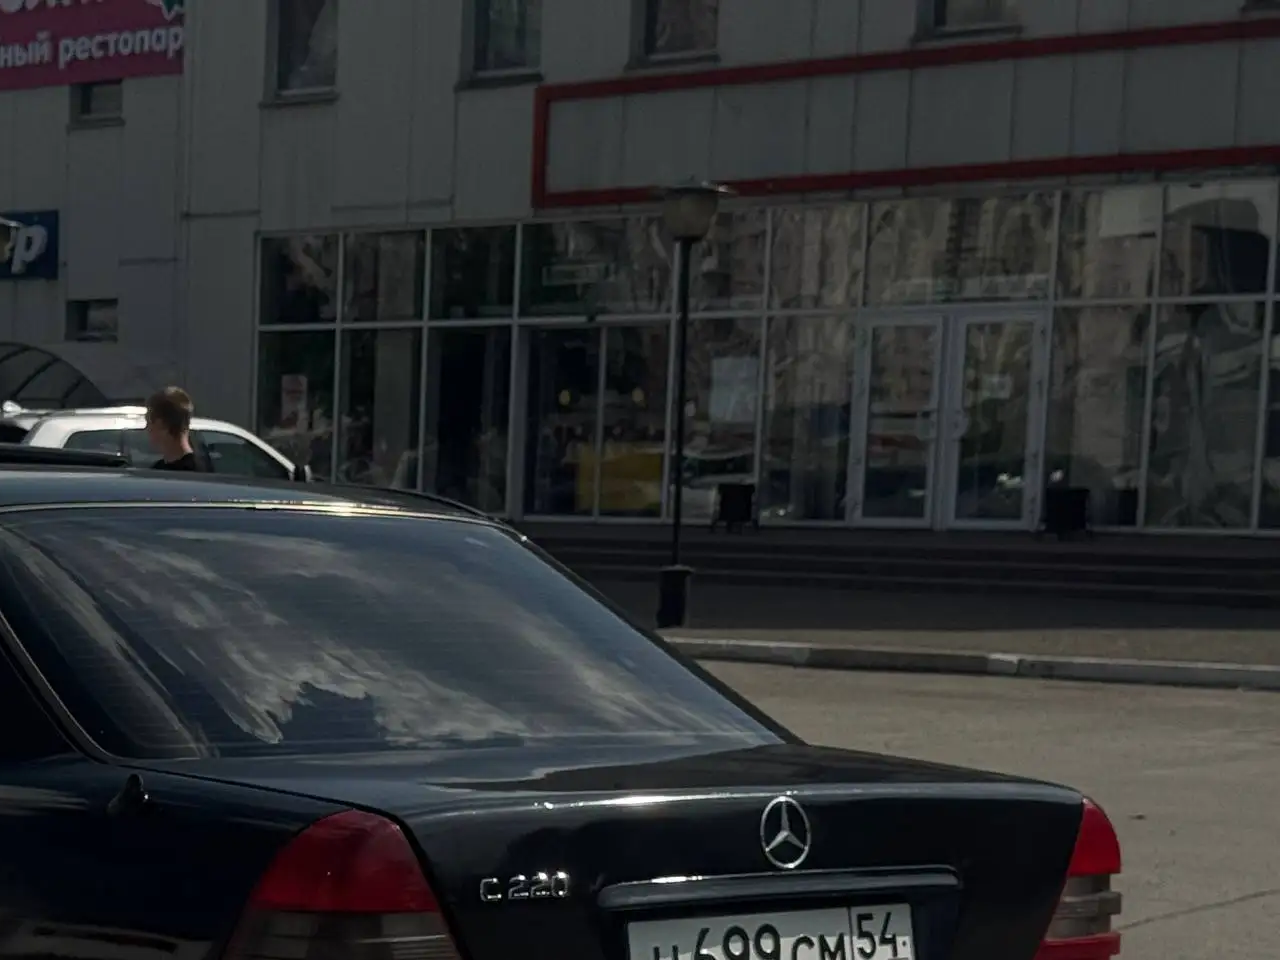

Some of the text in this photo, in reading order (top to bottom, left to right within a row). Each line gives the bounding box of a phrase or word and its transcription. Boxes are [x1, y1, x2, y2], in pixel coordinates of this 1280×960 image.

[57, 25, 184, 70] рестопар
[507, 870, 571, 901] 220
[856, 911, 899, 960] 54
